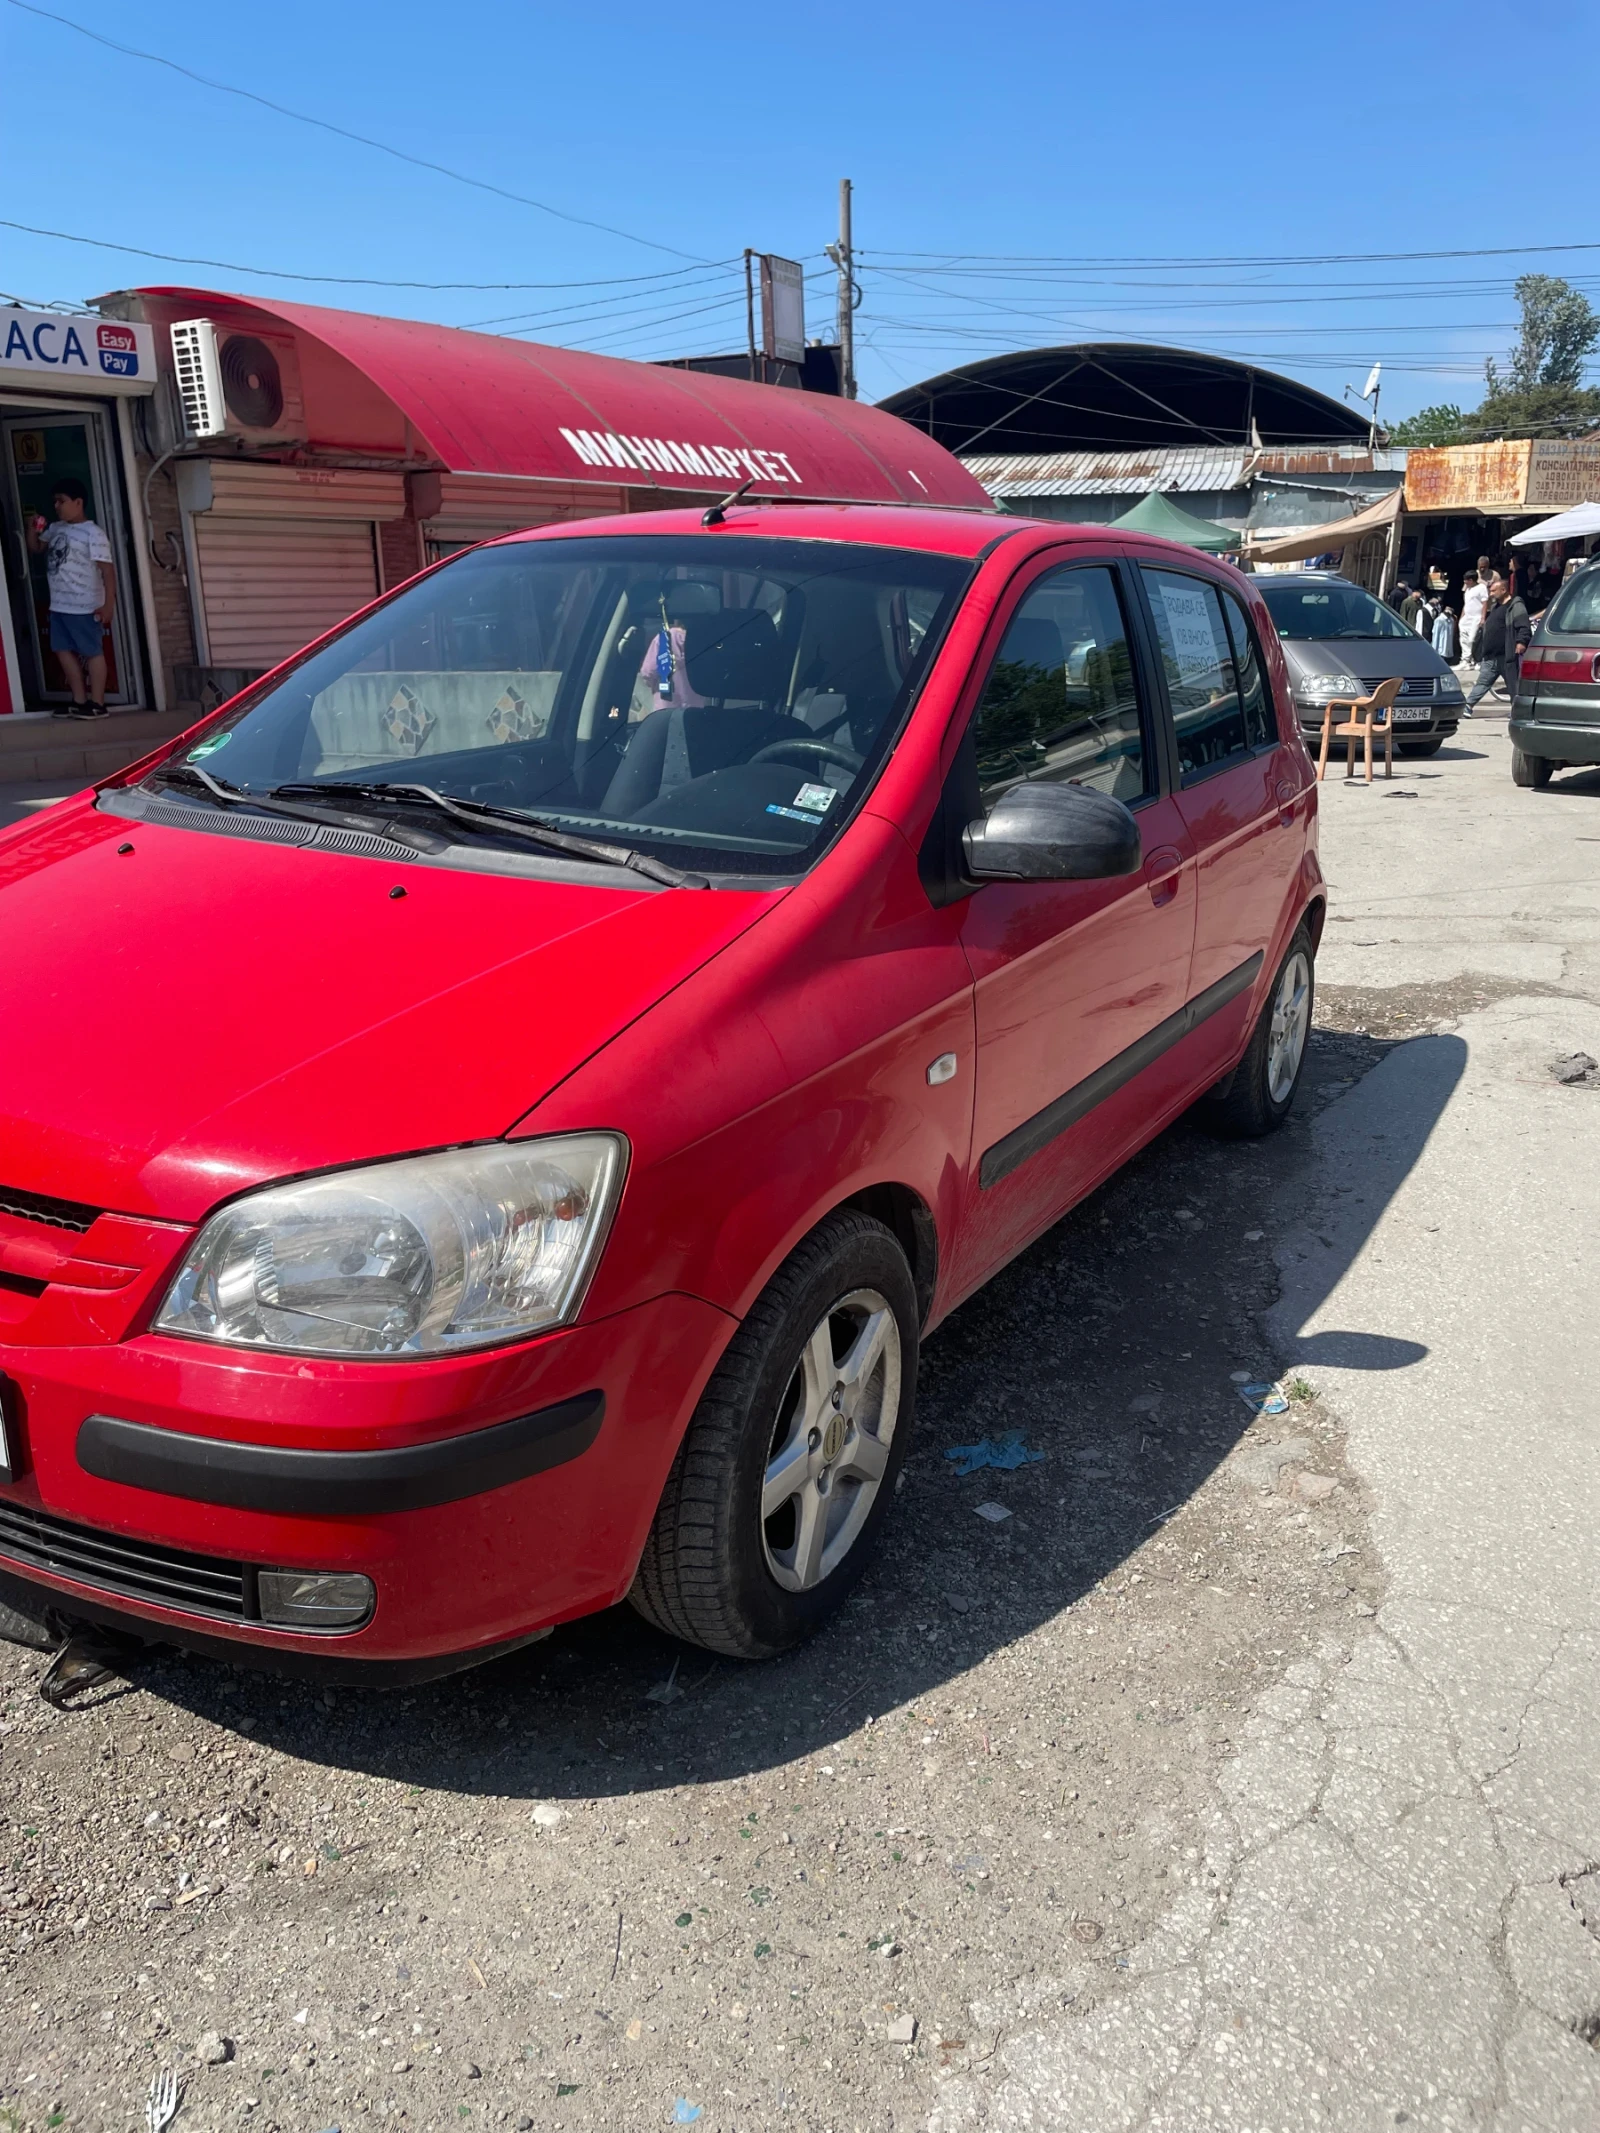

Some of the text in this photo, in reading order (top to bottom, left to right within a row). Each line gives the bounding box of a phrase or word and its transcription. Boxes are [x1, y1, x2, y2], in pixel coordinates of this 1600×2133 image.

[0, 320, 89, 366] АСА
[101, 330, 132, 351] Easy
[103, 352, 128, 373] Pay
[558, 427, 803, 483] МИНИМАРКЕТ
[1536, 460, 1600, 471] КОНСУЛТАТИВЕ
[1545, 471, 1580, 481] АДВОКАТ
[1537, 490, 1574, 501] ПРЕВОДИ
[1576, 491, 1582, 501] И
[1163, 596, 1207, 617] ПРОДАВА СЕ
[1397, 708, 1417, 719] 2826
[1419, 708, 1430, 719] HE
